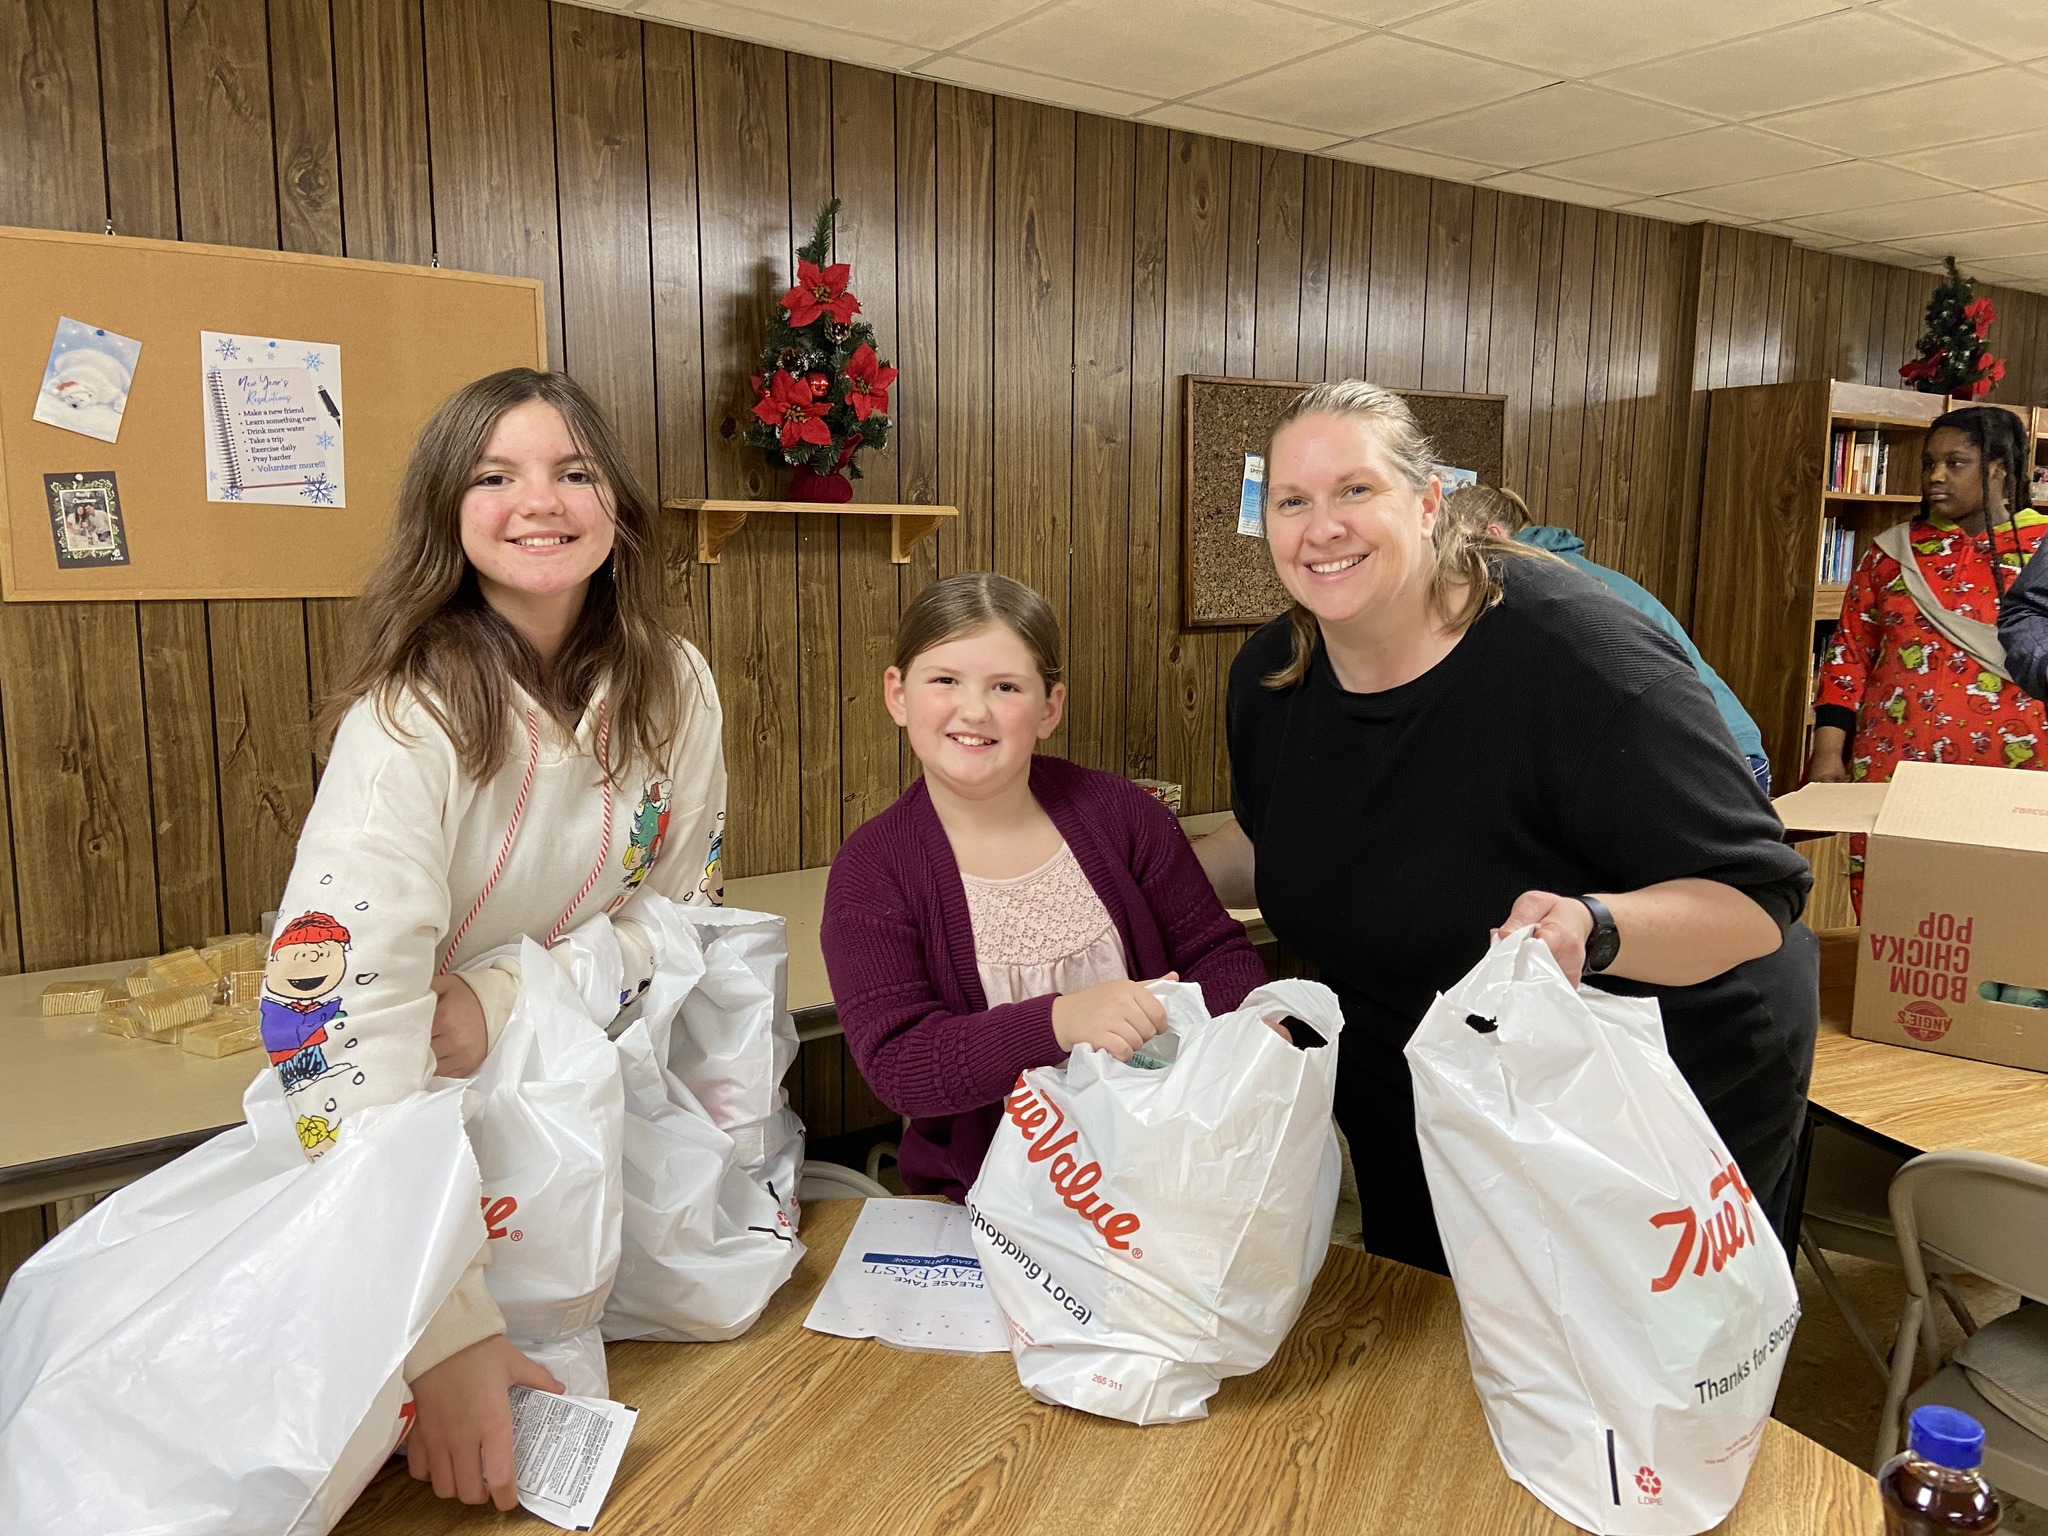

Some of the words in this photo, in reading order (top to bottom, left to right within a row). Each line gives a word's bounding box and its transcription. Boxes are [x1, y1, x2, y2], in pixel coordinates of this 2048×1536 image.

[238, 376, 256, 391] New
[260, 375, 288, 390] Year's
[246, 390, 292, 405] Resolutions
[272, 436, 284, 444] trip
[280, 444, 296, 452] daily
[257, 463, 297, 472] Volunteer
[298, 460, 326, 469] more!!!
[1918, 912, 1974, 944] POP
[1870, 933, 1970, 974] CHICKA
[1889, 966, 1968, 1004] BOOM
[1898, 1010, 1953, 1032] ANGIE'S
[1005, 1073, 1048, 1140] ue
[1027, 1088, 1141, 1251] Value
[1649, 1201, 1745, 1292] True
[923, 1257, 950, 1265] UNTIL
[969, 1203, 1042, 1281] Shopping
[1042, 1272, 1093, 1326] Local
[864, 1264, 984, 1281] EAKFAST
[894, 1276, 928, 1288] TAKE
[932, 1280, 984, 1289] PLEASE
[1694, 1360, 1750, 1404] Thanks
[1752, 1344, 1767, 1370] for
[1092, 1374, 1108, 1386] 265
[1108, 1378, 1124, 1392] 311
